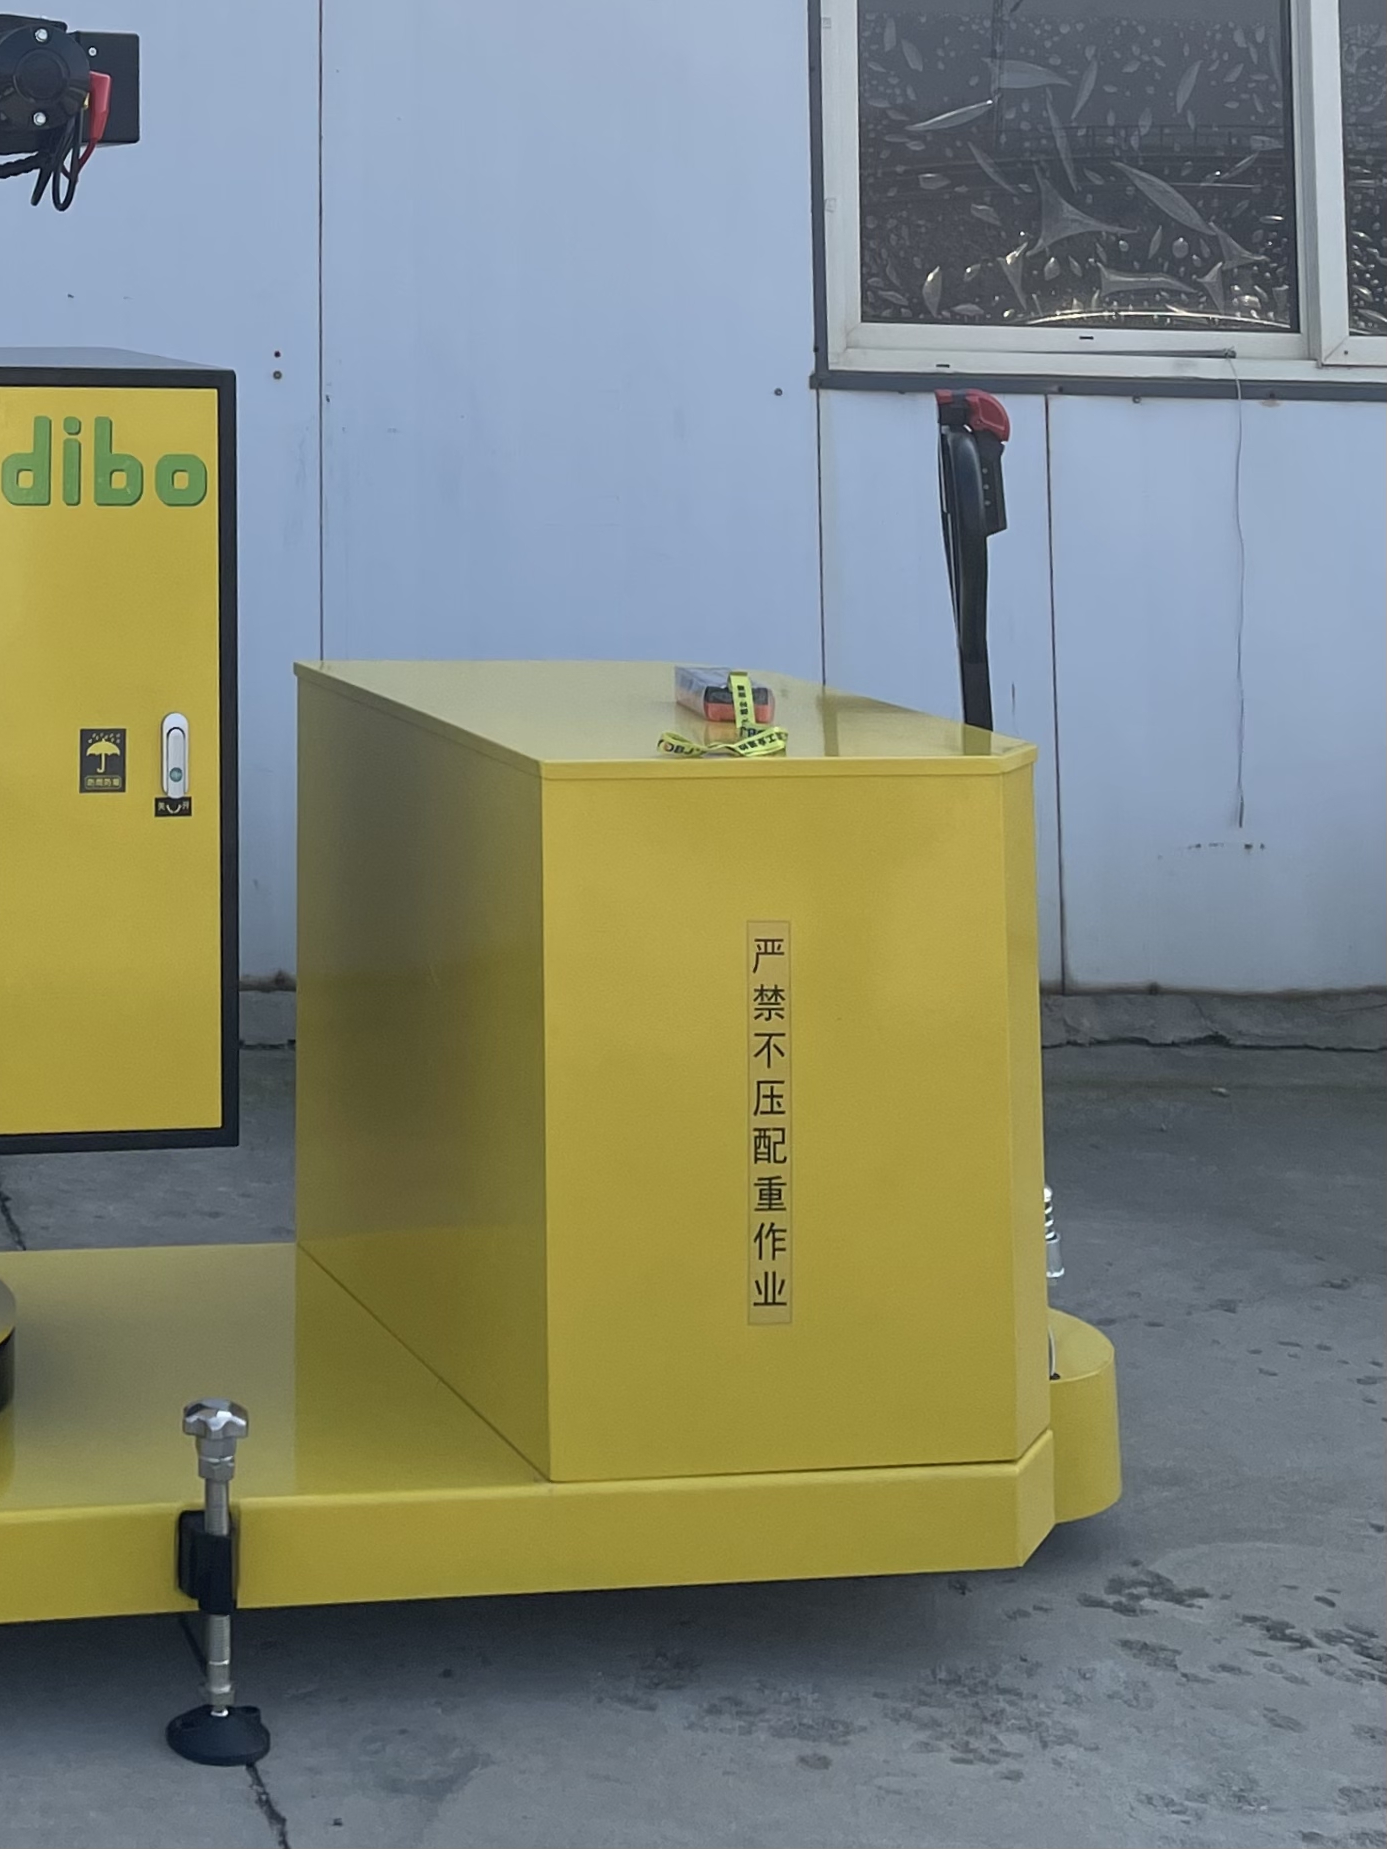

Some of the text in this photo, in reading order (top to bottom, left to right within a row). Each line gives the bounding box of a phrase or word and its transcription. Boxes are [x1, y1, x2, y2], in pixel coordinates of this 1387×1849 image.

[1, 416, 207, 507] dibo
[752, 937, 787, 1307] 严禁不压配重作业
